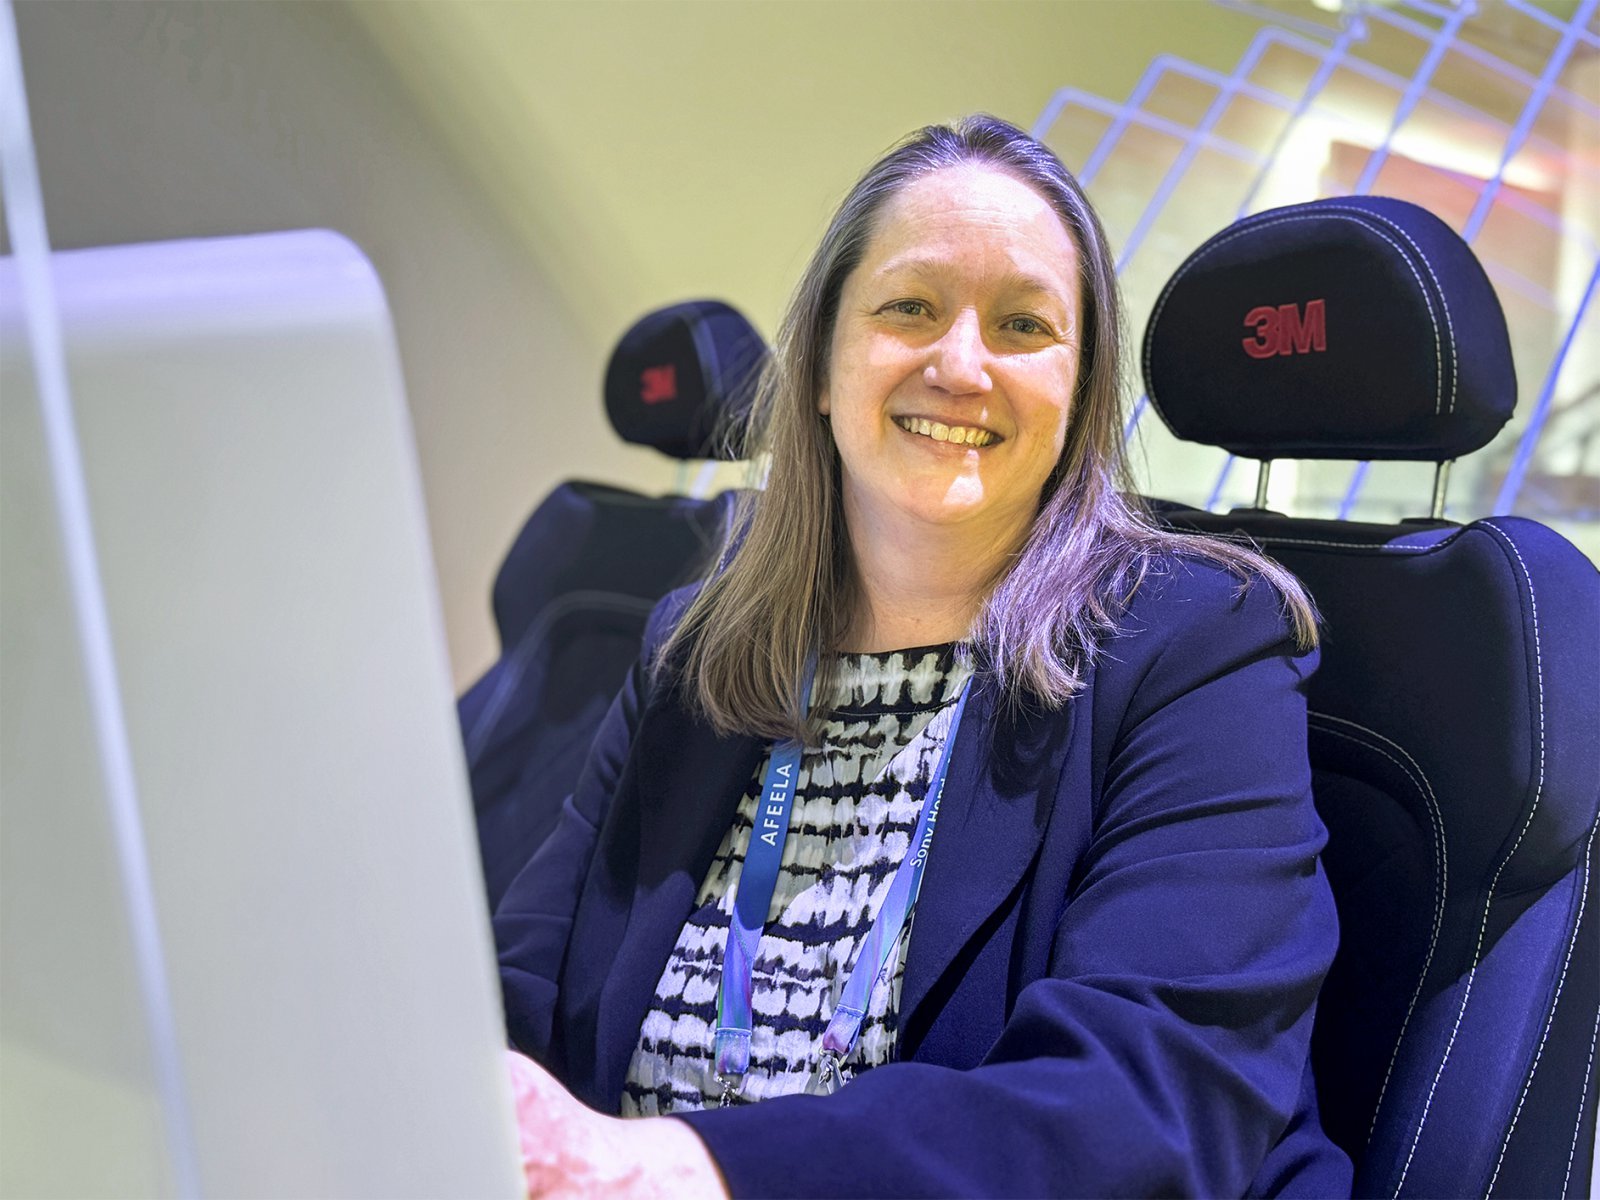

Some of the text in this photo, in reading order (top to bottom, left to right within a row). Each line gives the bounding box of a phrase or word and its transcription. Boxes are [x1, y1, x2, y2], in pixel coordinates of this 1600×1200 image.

[1242, 299, 1326, 359] 3M
[761, 763, 793, 847] AFEELA
[910, 828, 934, 868] Sony
